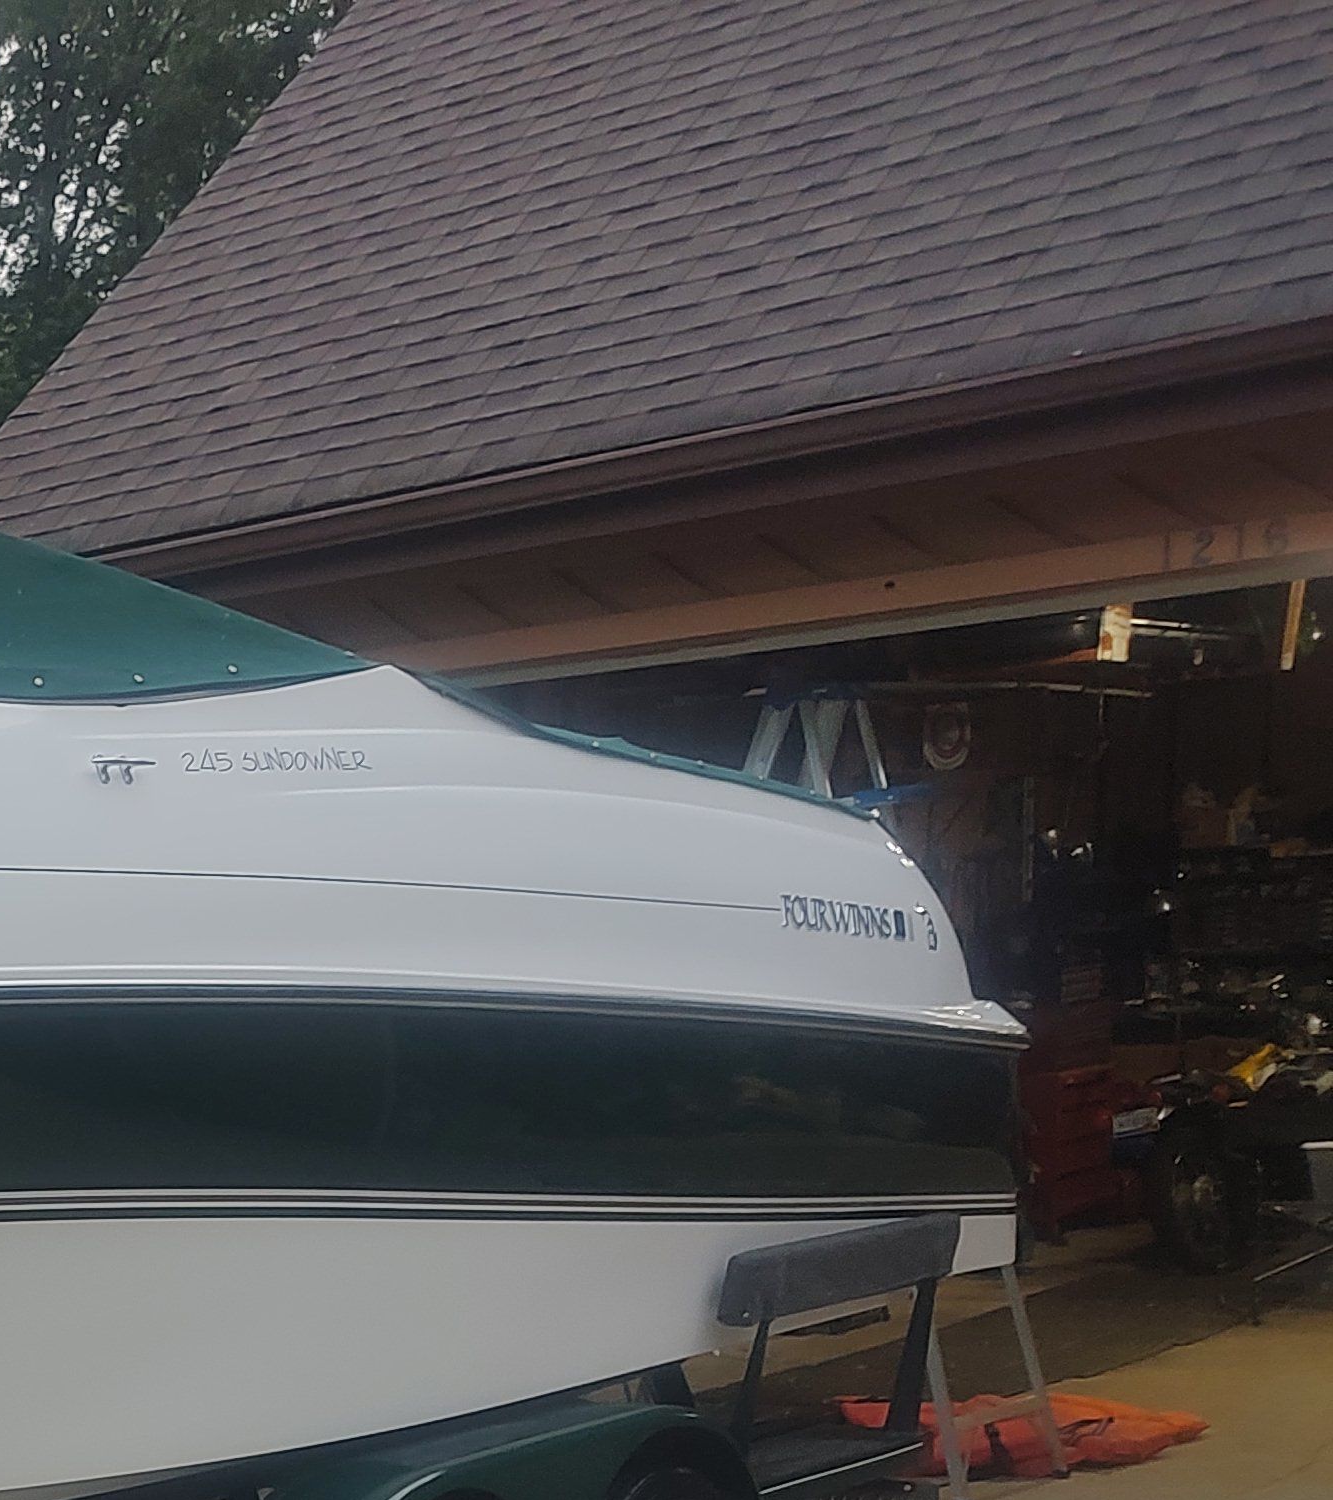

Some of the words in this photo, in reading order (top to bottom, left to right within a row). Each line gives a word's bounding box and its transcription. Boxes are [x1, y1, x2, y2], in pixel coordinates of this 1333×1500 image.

[180, 748, 233, 773] 245
[241, 747, 374, 773] SUNDOWNER
[780, 894, 833, 932] FOUR
[827, 900, 892, 938] WINNS
